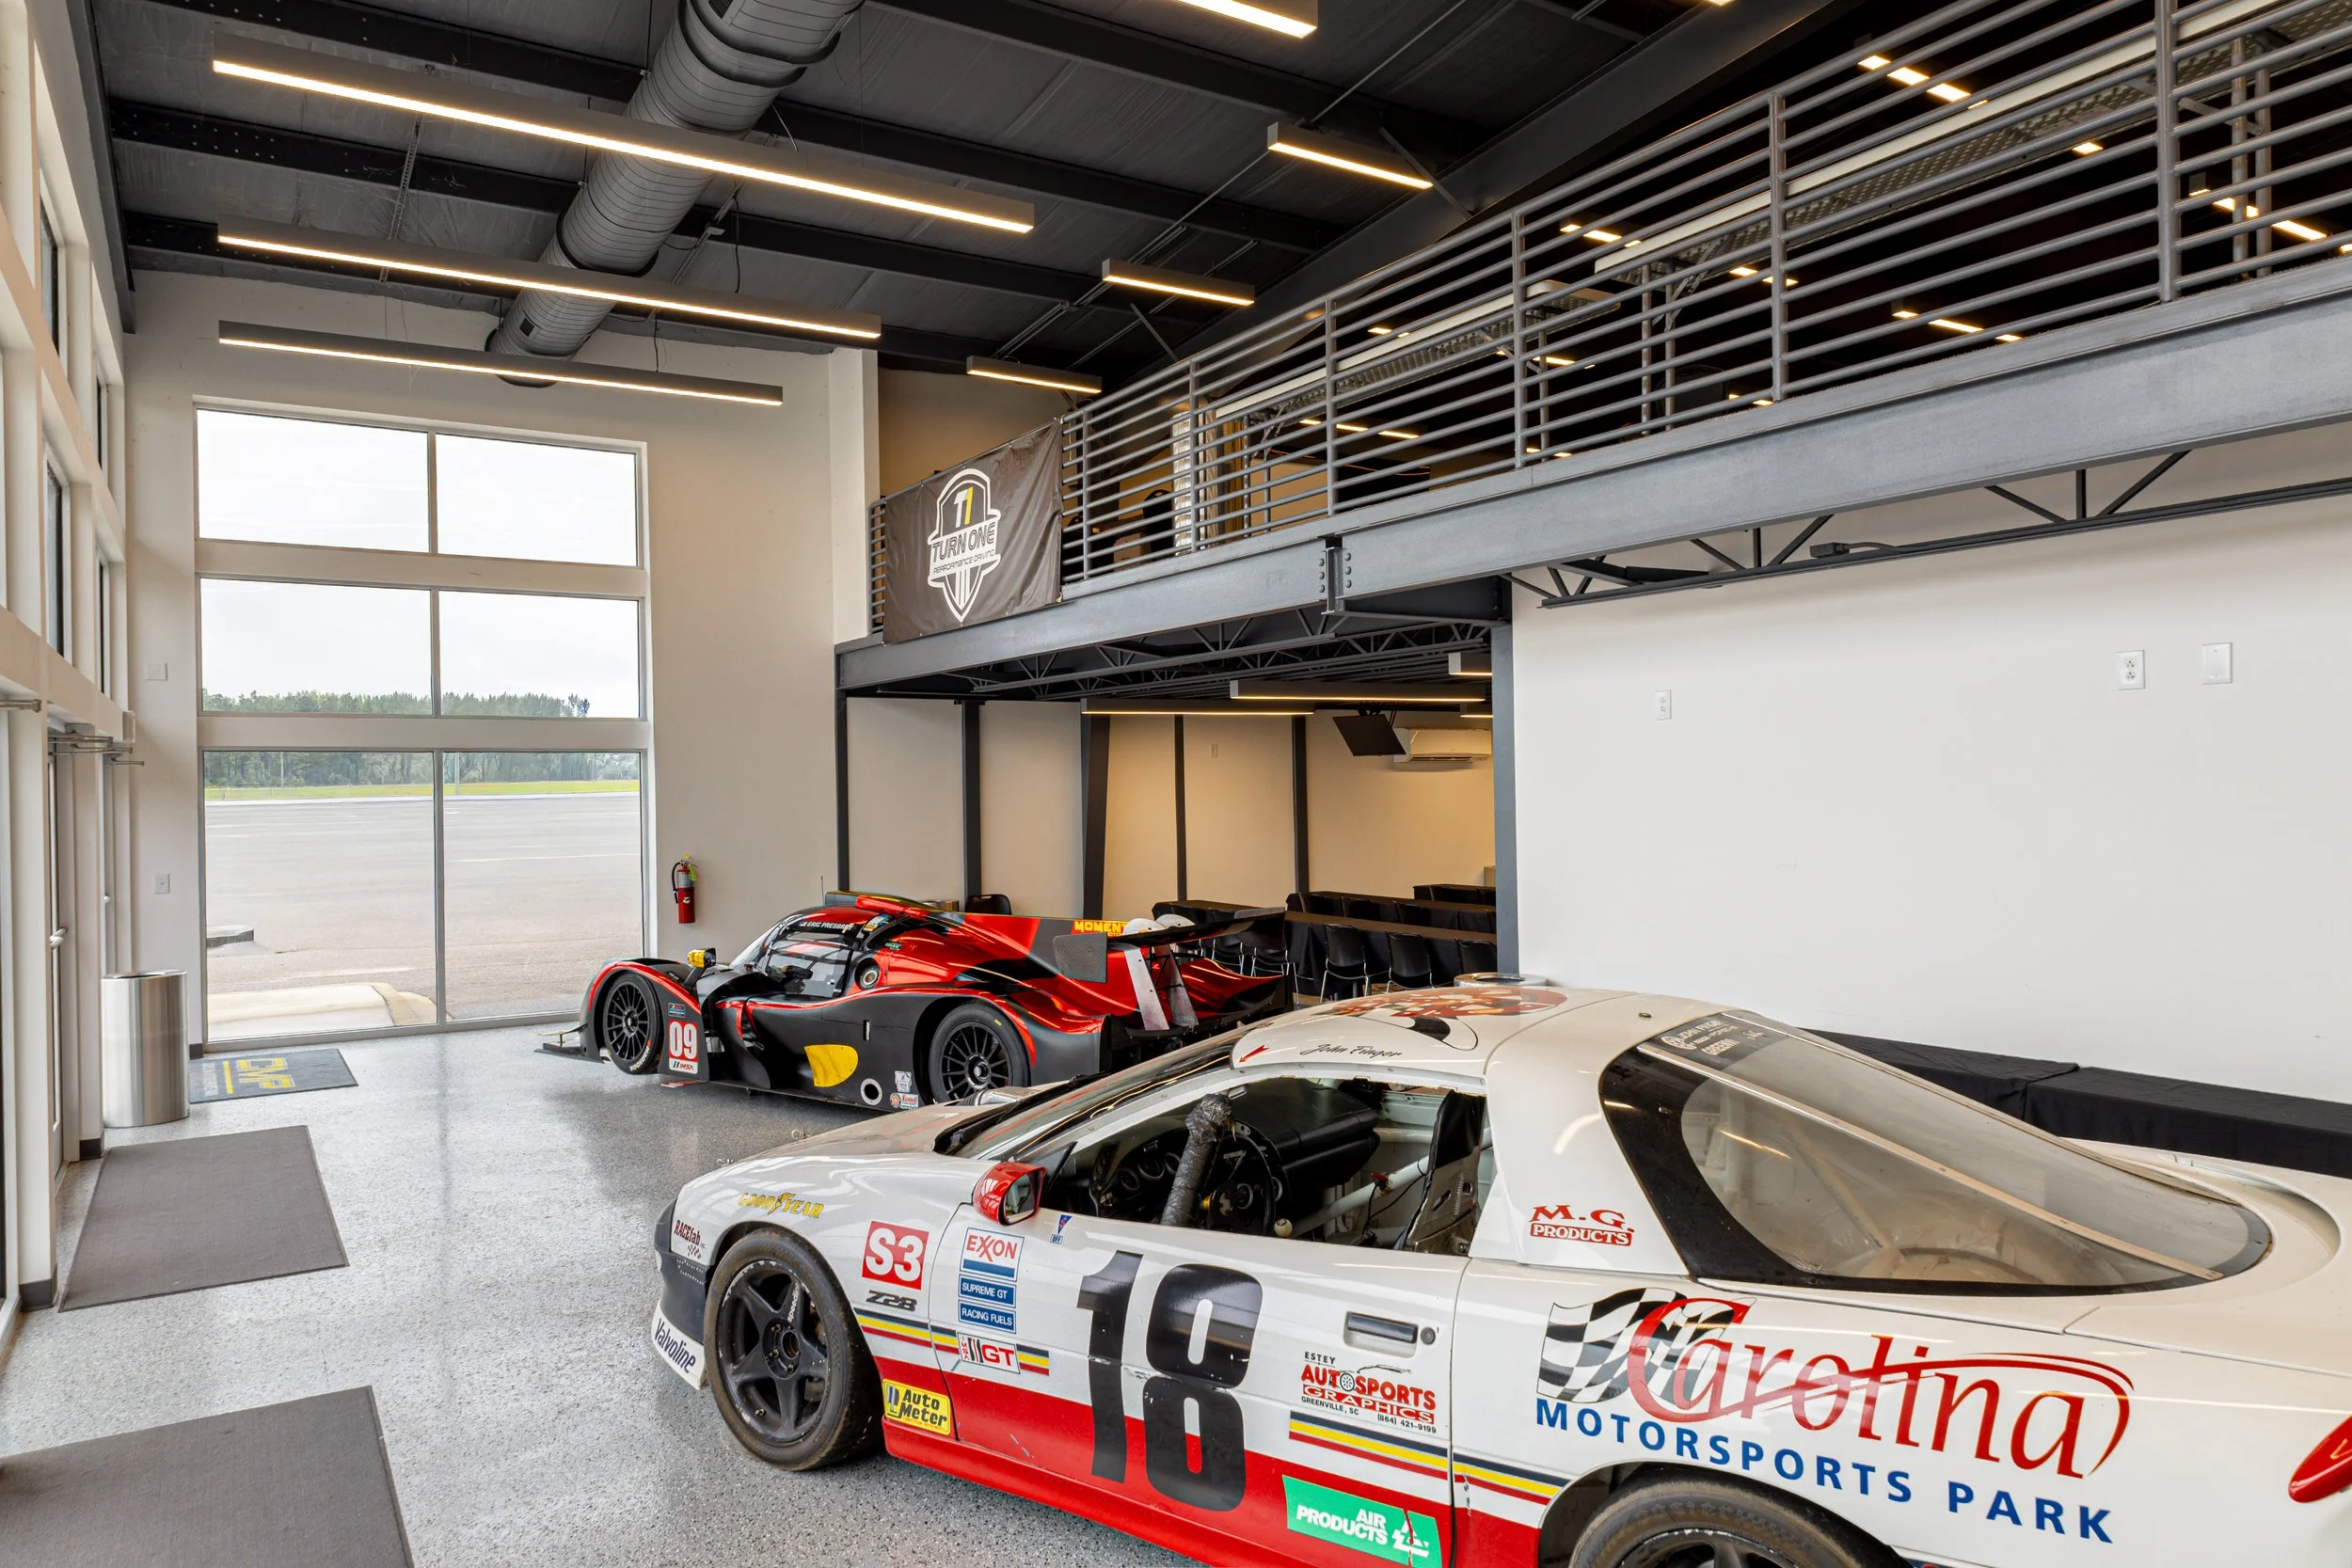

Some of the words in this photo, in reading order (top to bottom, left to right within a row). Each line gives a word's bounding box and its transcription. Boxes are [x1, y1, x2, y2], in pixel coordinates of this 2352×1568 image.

[932, 531, 967, 563] TURN
[968, 521, 996, 551] ONE
[669, 1021, 698, 1060] 09
[1299, 1043, 1348, 1055] John
[1349, 1045, 1403, 1059] Finger
[966, 1234, 1018, 1262] EXXON
[1533, 1224, 1632, 1246] PRODUCTS
[866, 1227, 924, 1282] S3
[866, 1290, 917, 1311] Z28
[961, 1281, 995, 1298] SUPREME
[996, 1288, 1009, 1300] GT
[961, 1307, 990, 1322] RACING
[990, 1313, 1012, 1326] FUELS
[655, 1317, 697, 1374] Valvoline
[981, 1343, 1015, 1367] GT
[1304, 1351, 1337, 1365] ESTEY
[1076, 1249, 1263, 1513] 18
[1301, 1364, 1437, 1411] AUTOSPORTS
[1628, 1298, 2090, 1481] Carolina
[901, 1388, 941, 1411] Auto
[1304, 1385, 1434, 1424] GRAPHICS
[1349, 1406, 1359, 1416] SC
[898, 1401, 948, 1427] Meter
[1377, 1413, 1397, 1425] (864)
[1400, 1419, 1438, 1433] 421-9199
[1536, 1397, 1913, 1503] MOTORSPORTS
[1296, 1505, 1389, 1546] PRODUCTS
[1356, 1508, 1388, 1530] AIR
[1947, 1481, 2115, 1544] PARK
